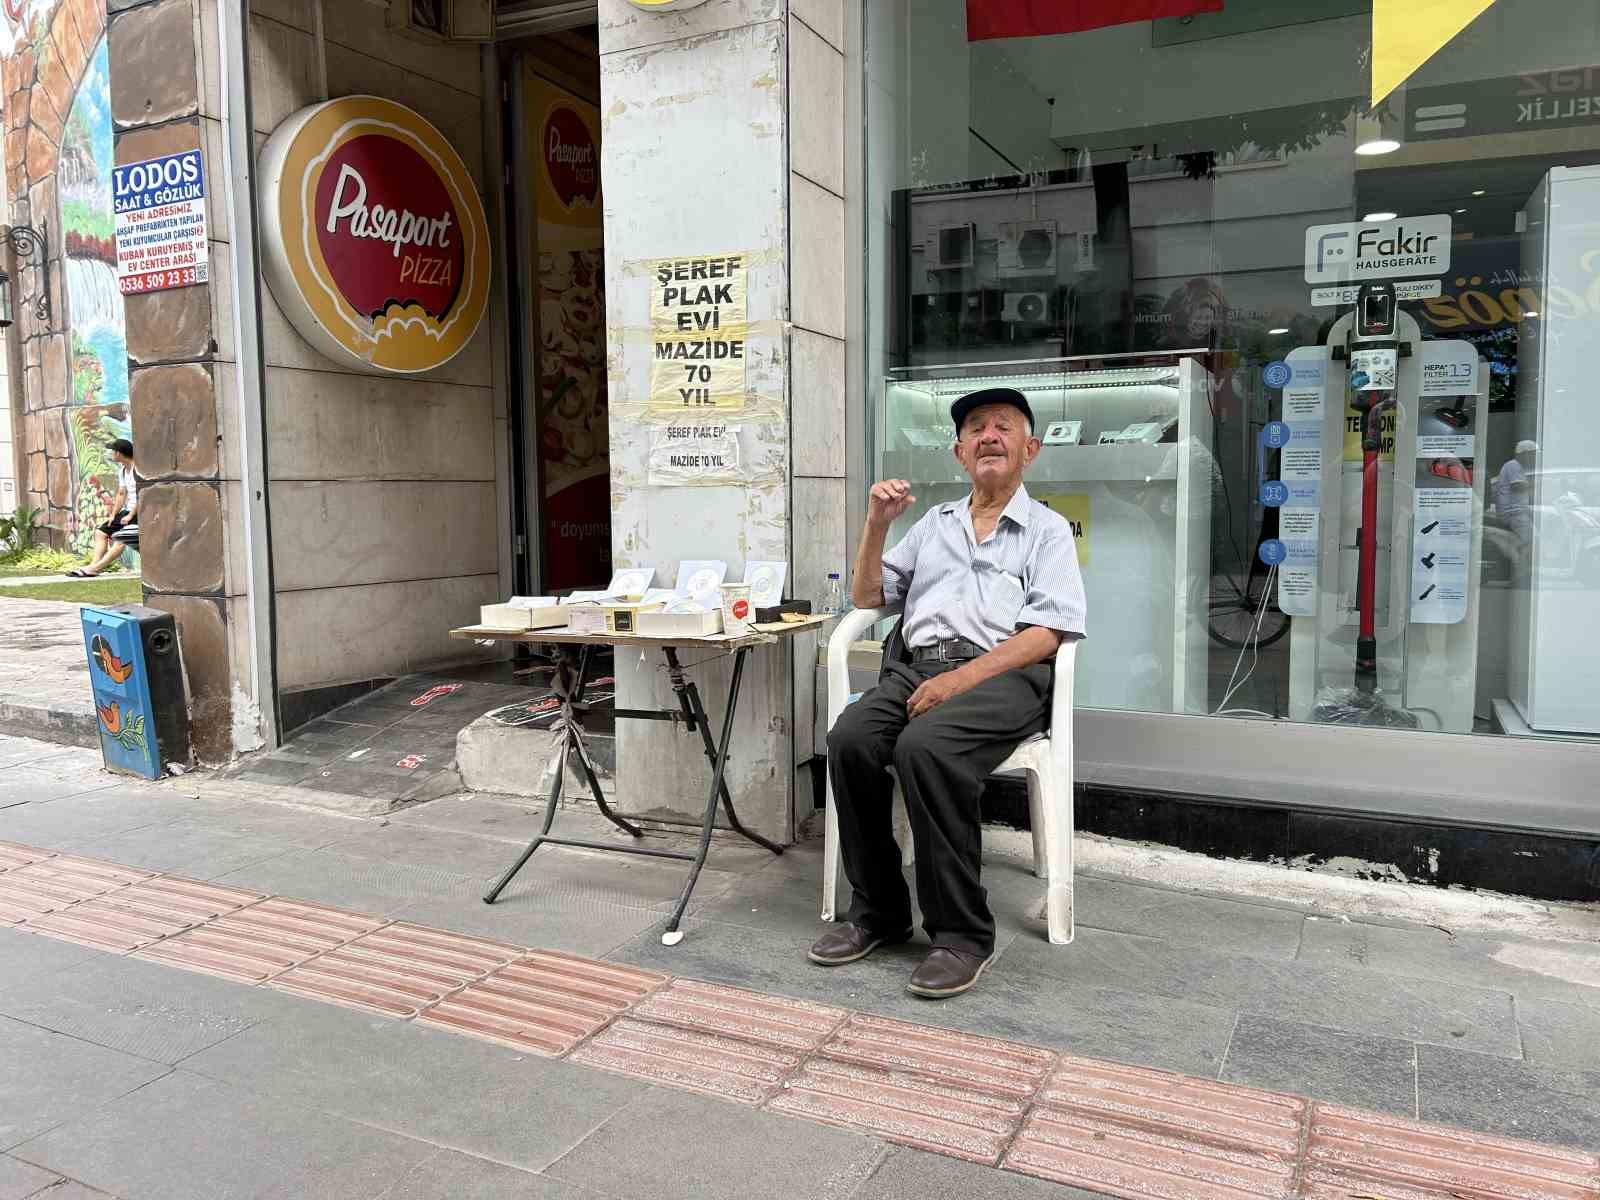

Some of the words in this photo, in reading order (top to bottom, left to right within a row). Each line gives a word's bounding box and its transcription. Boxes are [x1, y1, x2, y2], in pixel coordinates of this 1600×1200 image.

[115, 155, 198, 195] LODOS
[115, 196, 141, 212] SAAT
[144, 194, 152, 206] &
[154, 183, 202, 203] GÖZLÜK
[126, 211, 145, 223] YENİ
[147, 203, 193, 219] ADRESİMİZ
[326, 163, 452, 257] Pasaport
[119, 249, 144, 261] KUBAN
[147, 241, 193, 257] KURUYEMİŞ
[1357, 226, 1438, 258] Fakir
[128, 262, 138, 272] EV
[140, 257, 170, 271] CENTER
[173, 253, 197, 266] ARASI
[657, 257, 742, 287] ŞEREF
[1356, 255, 1438, 270] HAUSGERÄTE
[120, 277, 144, 292] 0536
[146, 273, 165, 289] 509
[167, 270, 180, 285] 23
[183, 269, 196, 282] 33
[663, 284, 734, 307] PLAK
[677, 306, 720, 331] EVİ
[655, 337, 744, 360] MAZİDE
[685, 365, 712, 383] 70
[679, 388, 716, 407] YIL
[667, 427, 691, 440] ŞEREF
[670, 453, 700, 467] MAZİDE
[711, 455, 724, 467] YIL
